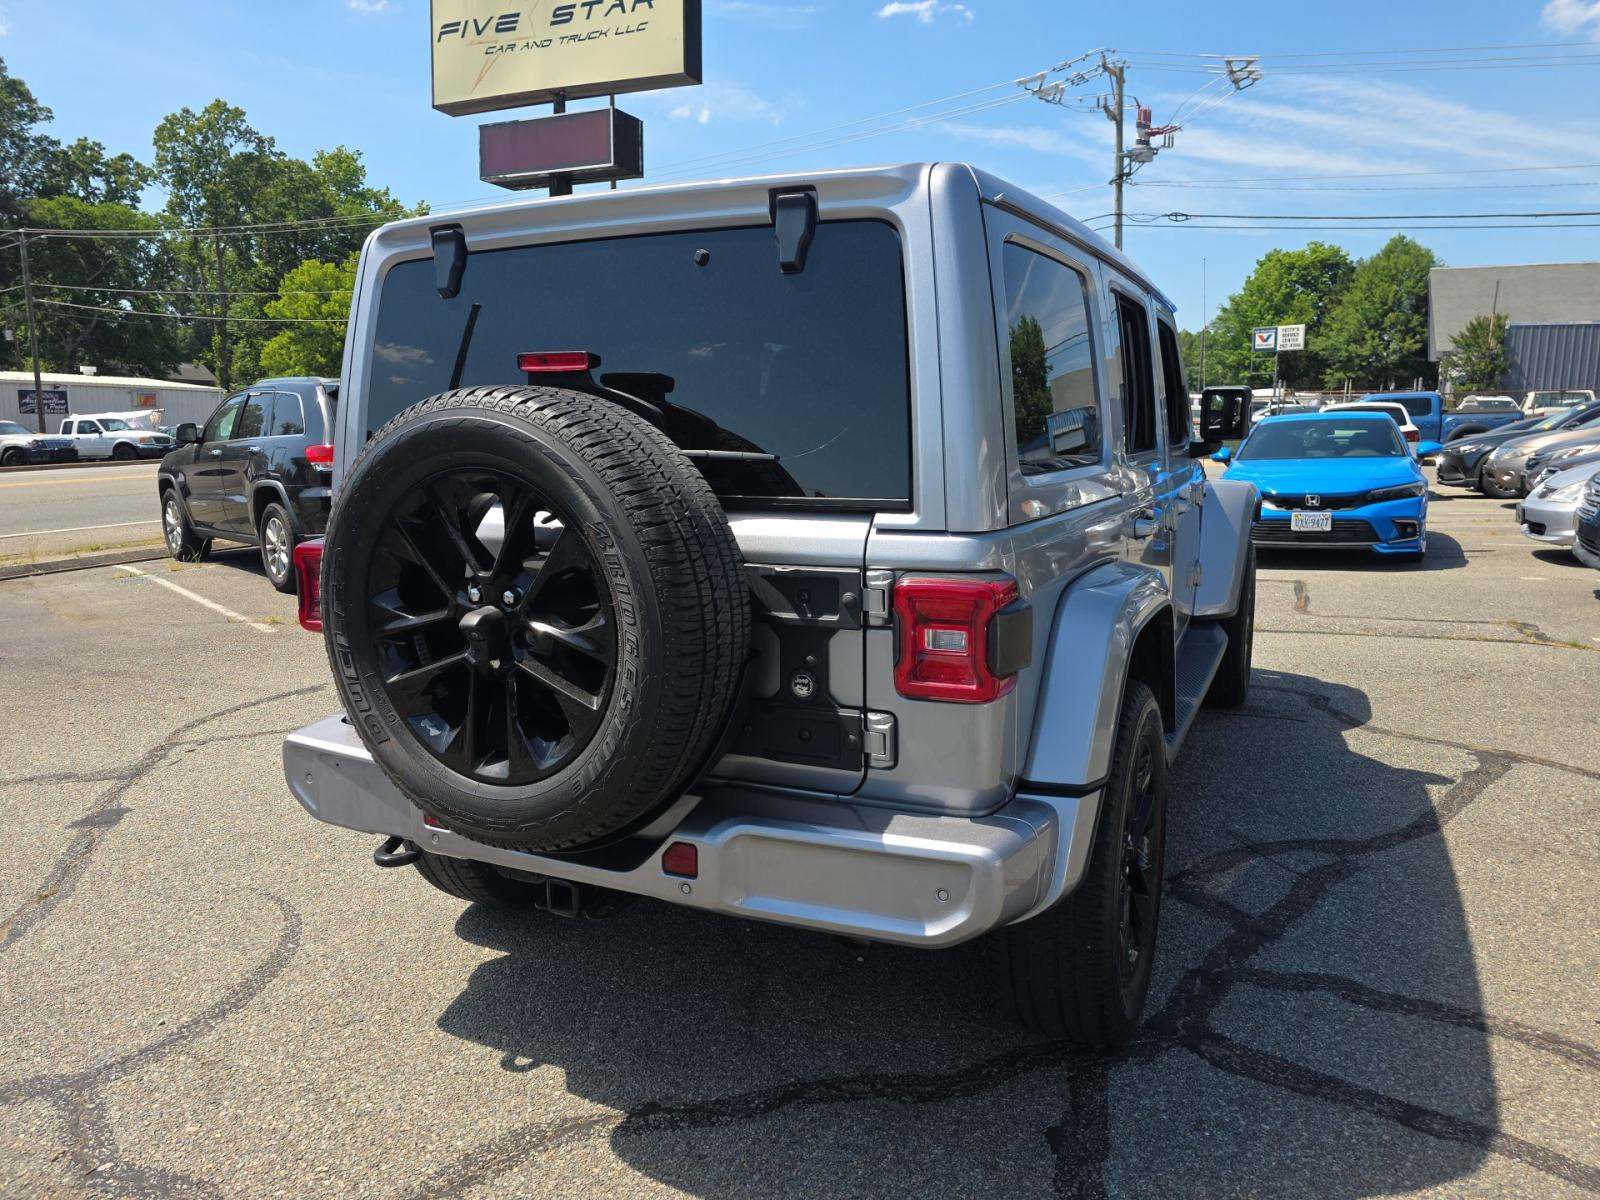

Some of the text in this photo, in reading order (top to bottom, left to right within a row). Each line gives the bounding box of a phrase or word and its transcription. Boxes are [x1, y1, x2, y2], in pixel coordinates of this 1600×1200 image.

[437, 0, 654, 43] FIVE STAR
[485, 22, 649, 55] CAR AND TRUCK LLC
